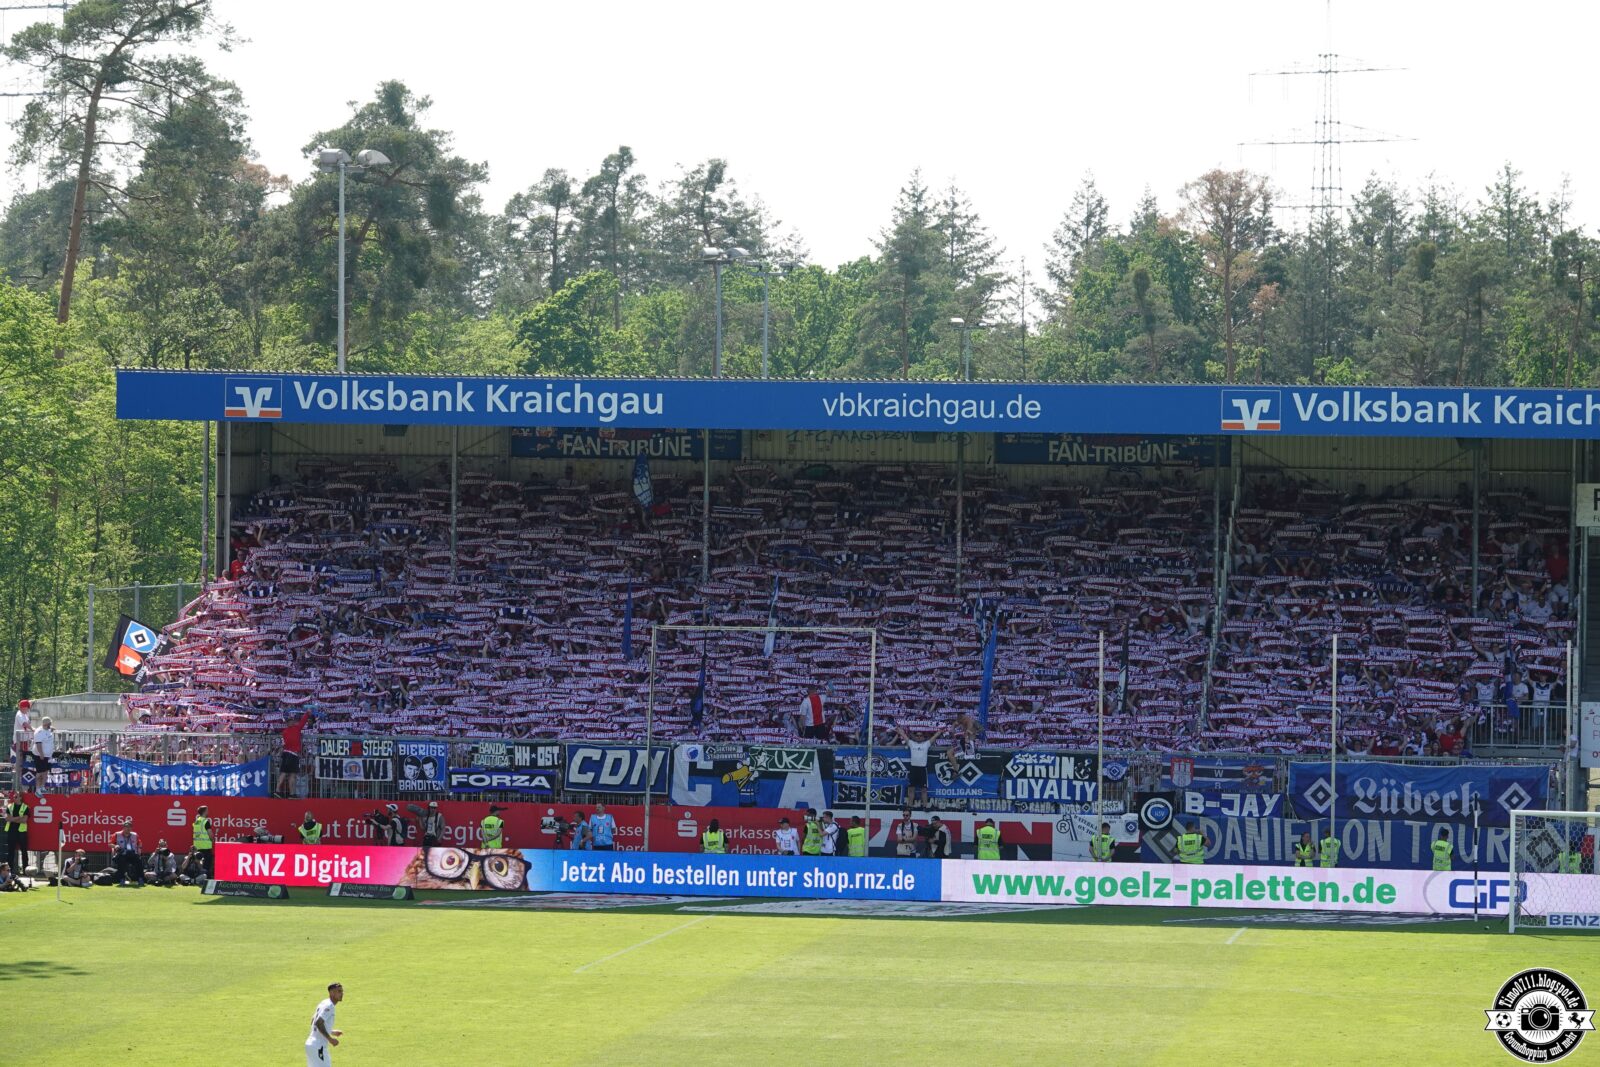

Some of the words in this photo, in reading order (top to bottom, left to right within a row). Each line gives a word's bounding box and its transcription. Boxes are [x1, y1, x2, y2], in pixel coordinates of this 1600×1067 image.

[294, 380, 474, 412] Volksbank
[486, 383, 663, 423] Kraichgau
[823, 393, 1042, 424] vbkraichgau.de
[1293, 391, 1482, 424] Volksbank
[1494, 393, 1600, 426] Kraich
[562, 435, 691, 457] FAN-TRIBÜNE
[320, 740, 349, 756] DAUER
[362, 740, 393, 757] STEHER
[398, 744, 445, 757] BIERIGE
[514, 746, 530, 766] HH
[537, 746, 560, 767] OST
[319, 758, 343, 778] HH
[362, 759, 388, 779] WJ
[568, 748, 666, 786] CDN
[398, 779, 446, 791] BANDITEN
[451, 774, 551, 788] FORZA
[935, 788, 983, 796] HOOLIGANS
[1006, 778, 1096, 801] LOYALTY
[1185, 792, 1281, 817] B-JAY
[1352, 777, 1483, 818] Lübeck
[61, 811, 133, 826] Sparkasse
[195, 815, 267, 829] parkasse
[1342, 818, 1392, 862] ON
[238, 853, 286, 877] RNZ
[294, 853, 370, 883] Digital
[560, 861, 605, 883] Jetzt
[611, 862, 645, 884] Abo
[653, 864, 739, 886] bestellen
[746, 867, 797, 888] unter
[803, 867, 915, 892] shop.rnz.de
[972, 871, 1397, 906] www.goelz-paletten.de
